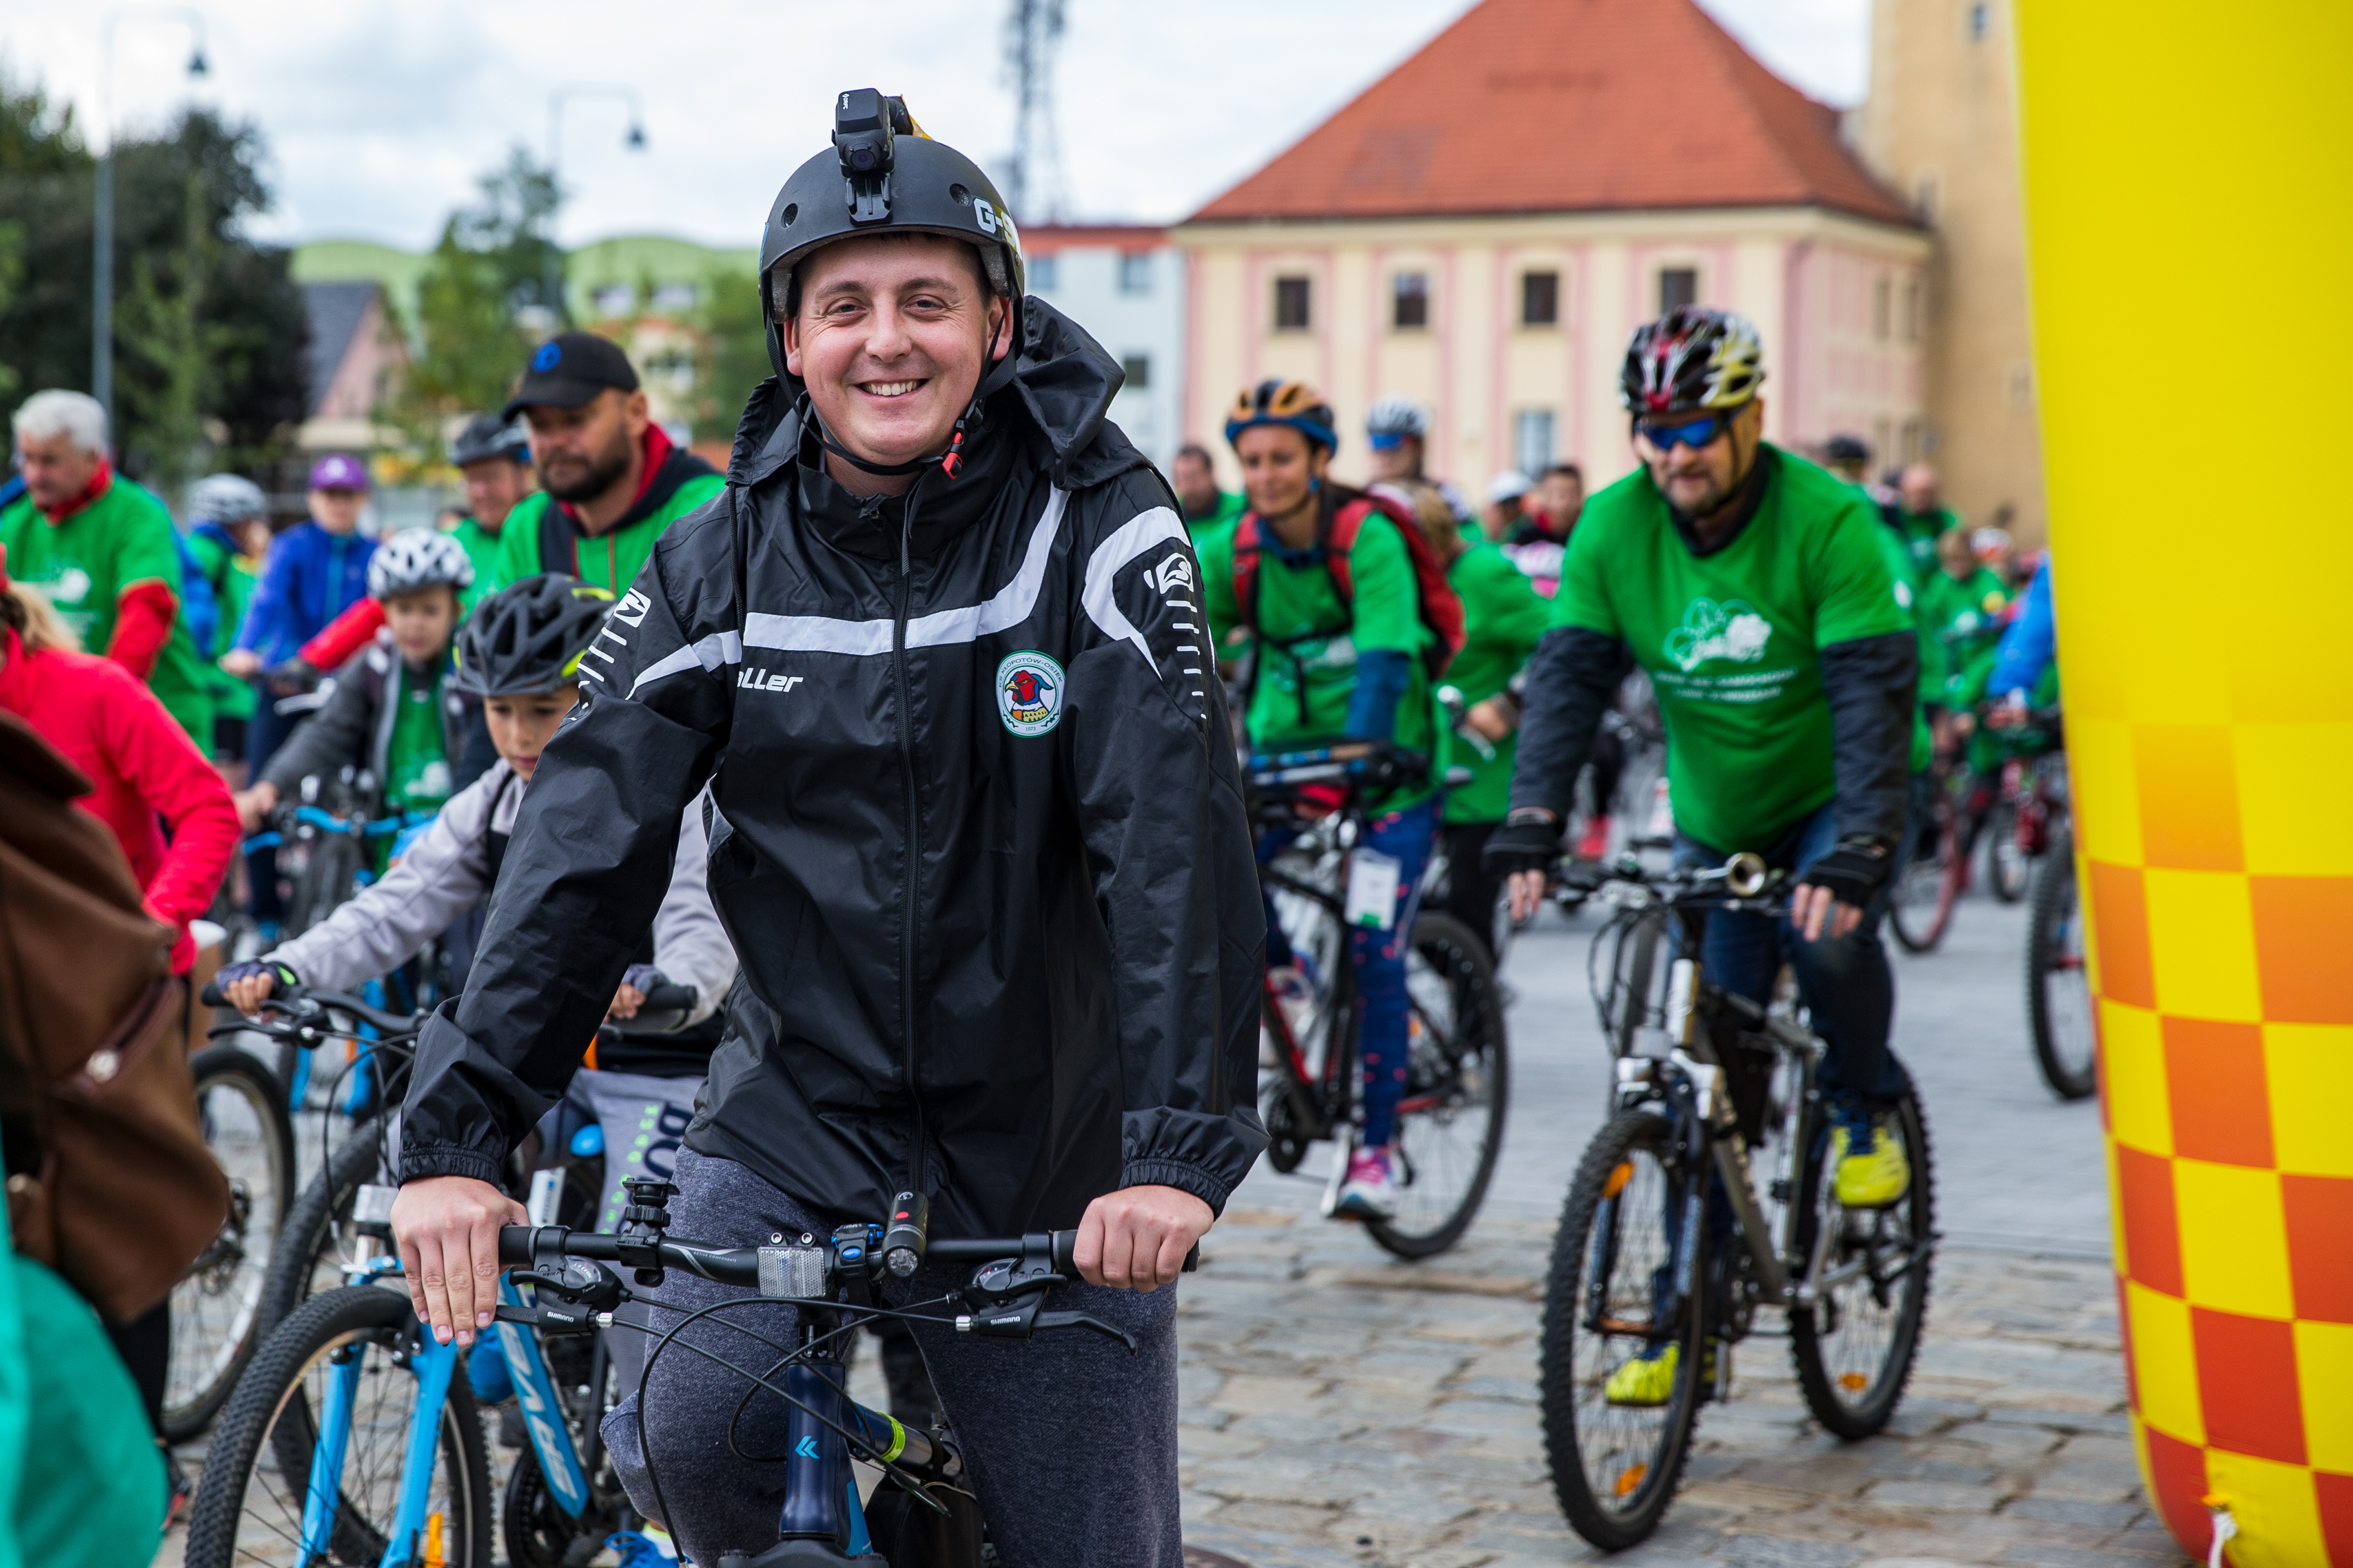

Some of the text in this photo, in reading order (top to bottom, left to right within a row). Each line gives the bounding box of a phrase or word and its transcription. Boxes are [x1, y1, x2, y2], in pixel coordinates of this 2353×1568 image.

[998, 656, 1063, 687] KS KŁOPOTÓW-OSIEK
[709, 1254, 737, 1263] COMPONENTS
[547, 1311, 574, 1323] SHIMANO
[990, 1315, 1021, 1325] SHIMANO
